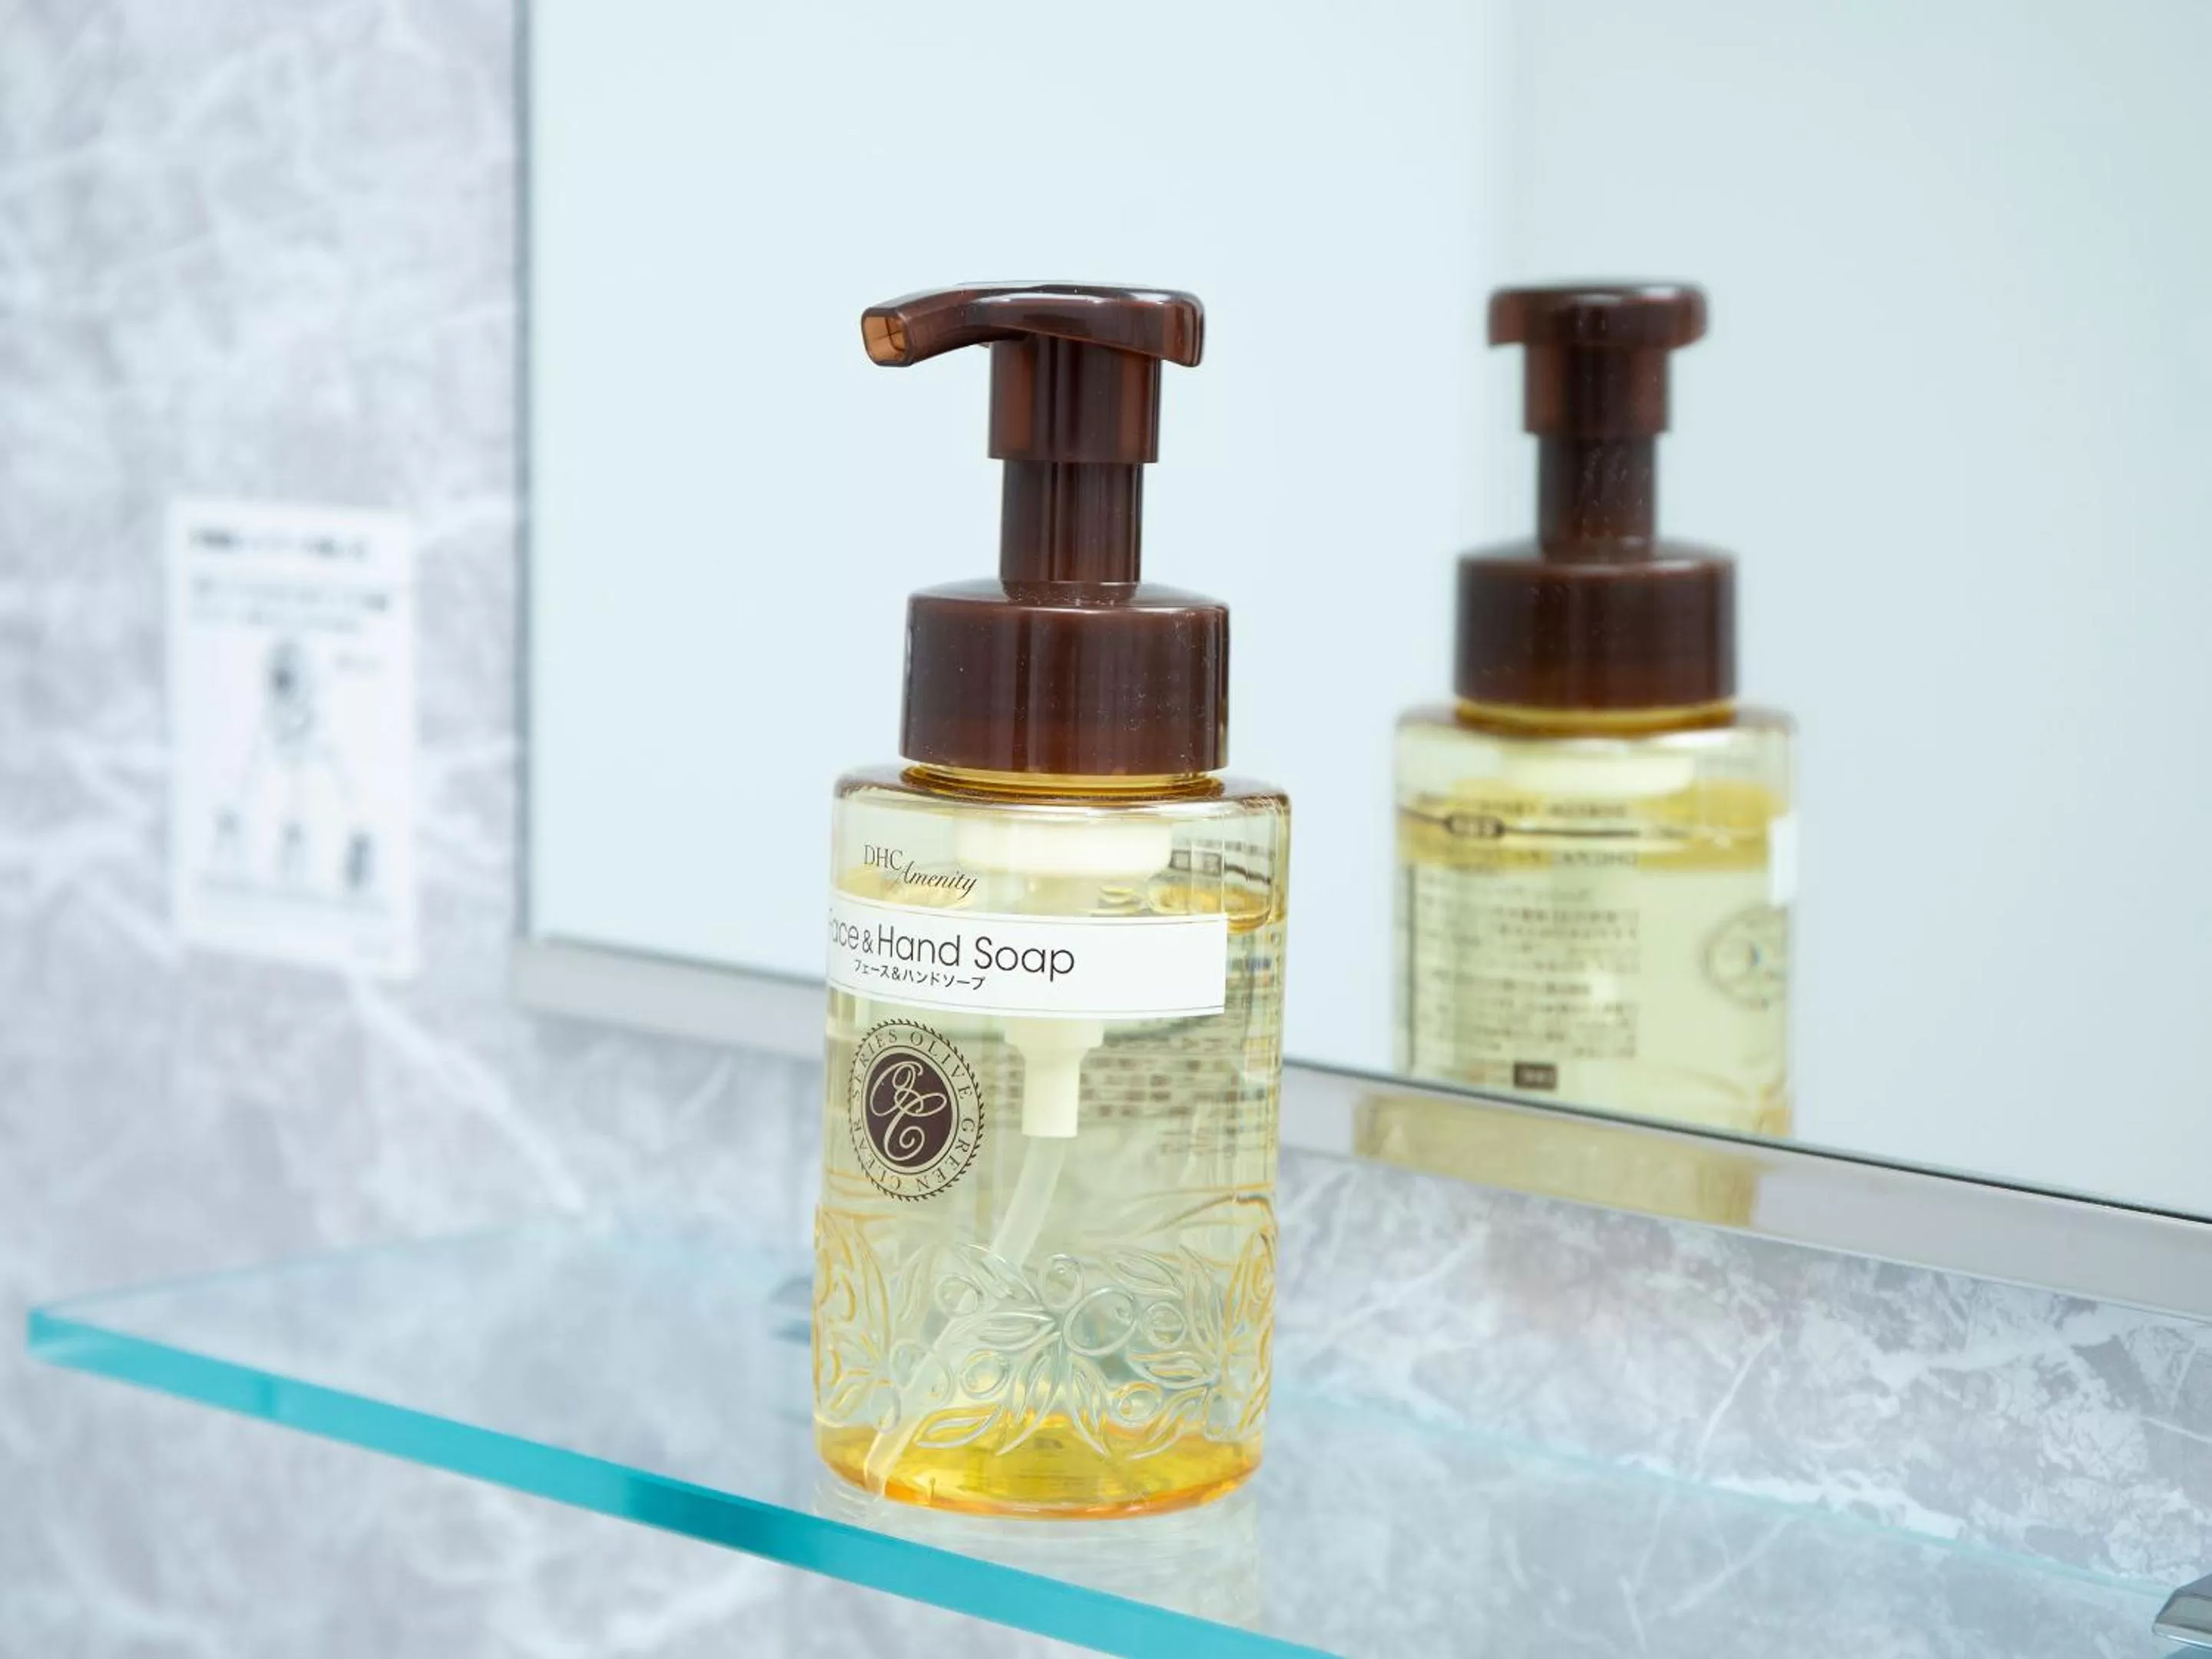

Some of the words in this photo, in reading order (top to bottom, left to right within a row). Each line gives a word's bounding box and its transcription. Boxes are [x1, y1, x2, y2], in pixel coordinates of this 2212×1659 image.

[863, 844, 903, 870] DHC
[892, 860, 978, 900] Amenity
[974, 935, 1075, 983] Soap
[909, 1031, 973, 1100] OLIVE
[915, 1117, 976, 1192] GREEN
